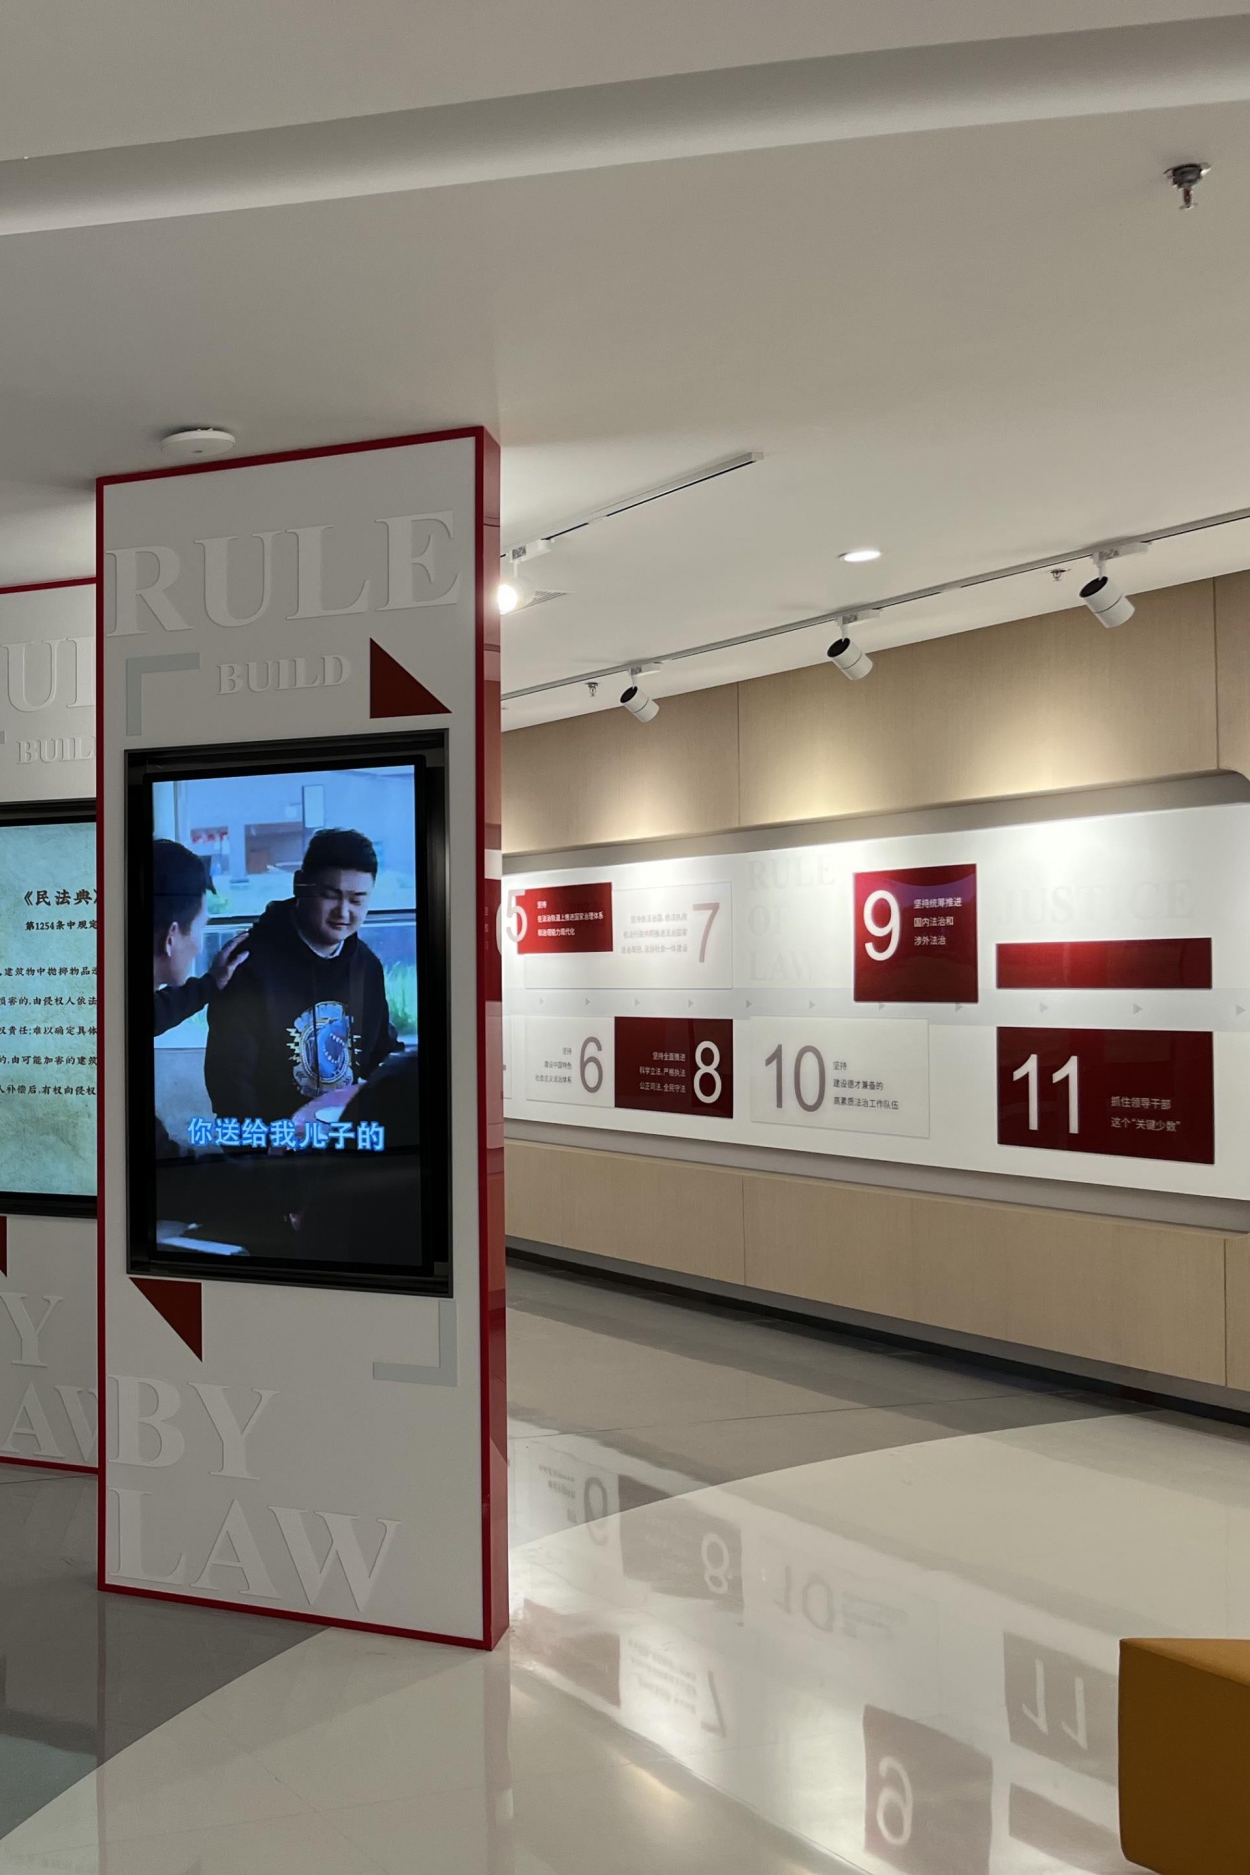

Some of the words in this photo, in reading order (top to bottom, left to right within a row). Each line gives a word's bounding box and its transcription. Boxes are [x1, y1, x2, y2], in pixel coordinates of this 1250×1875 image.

[105, 510, 461, 638] RULE
[216, 654, 350, 695] BUILD
[506, 889, 528, 943] 5
[863, 889, 901, 962] 9
[913, 897, 962, 909] 坚持统筹推进
[913, 916, 954, 928] 国内法治和
[692, 902, 720, 963] 7
[914, 935, 946, 946] 涉外法治
[580, 1036, 604, 1094] 6
[693, 1040, 722, 1104] 8
[765, 1044, 826, 1112] 10
[833, 1061, 847, 1071] 坚持
[833, 1078, 884, 1091] 建设德才兼备的
[833, 1096, 899, 1110] 高素质法治工作队伍
[1012, 1053, 1079, 1134] 11
[1110, 1095, 1172, 1110] 抓住领导干部
[187, 1117, 385, 1151] 你送给我儿子的
[107, 1374, 281, 1481] BY
[108, 1487, 402, 1612] LAW
